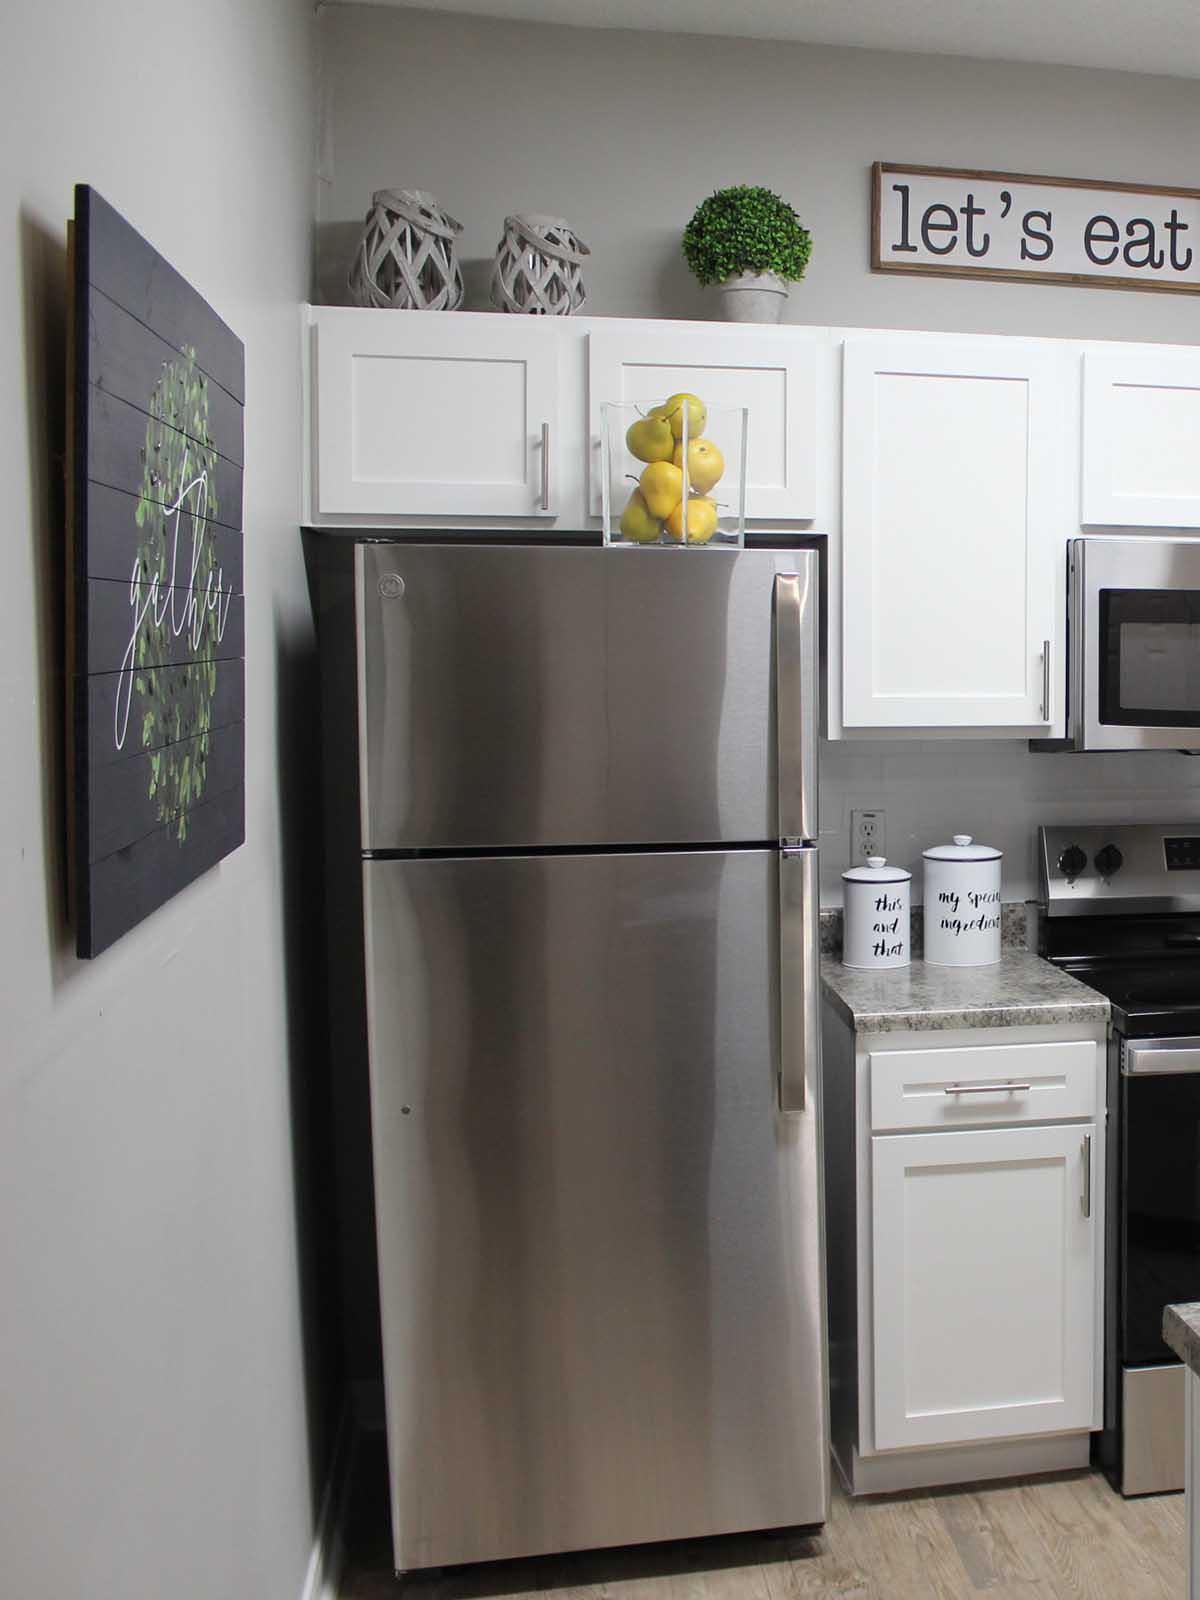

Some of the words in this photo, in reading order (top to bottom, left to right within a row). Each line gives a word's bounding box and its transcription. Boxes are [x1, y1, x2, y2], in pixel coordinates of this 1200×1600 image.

[891, 184, 1054, 262] let's
[1084, 209, 1193, 271] eat
[115, 446, 233, 751] gather
[874, 893, 902, 911] this
[938, 891, 960, 913] my
[967, 890, 1000, 909] specia
[873, 917, 899, 934] and
[872, 938, 904, 957] that
